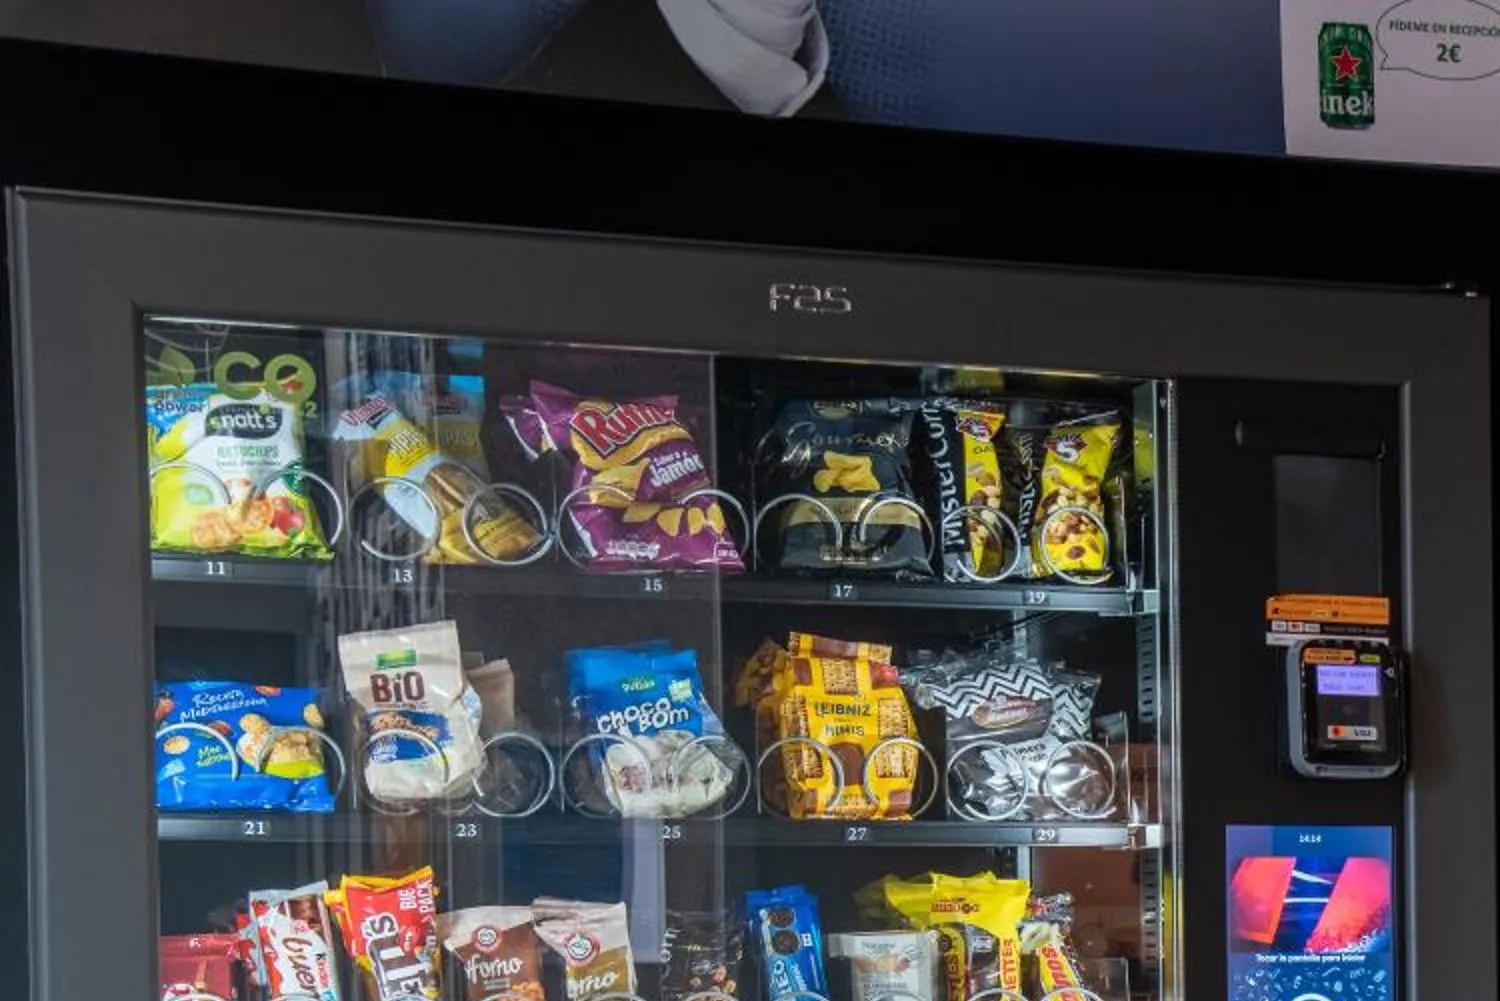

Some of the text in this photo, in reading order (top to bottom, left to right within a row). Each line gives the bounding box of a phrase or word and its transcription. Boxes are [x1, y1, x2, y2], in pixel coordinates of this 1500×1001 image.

[1432, 23, 1446, 34] EN
[1436, 43, 1462, 63] 2€
[206, 562, 225, 575] 11
[393, 570, 412, 583] 13
[644, 579, 663, 592] 15
[834, 585, 854, 598] 17
[1026, 592, 1044, 604] 19
[813, 702, 872, 717] LEIBNIZ
[244, 823, 266, 836] 21
[456, 824, 477, 838] 23
[663, 826, 681, 839] 25
[847, 828, 867, 840] 27
